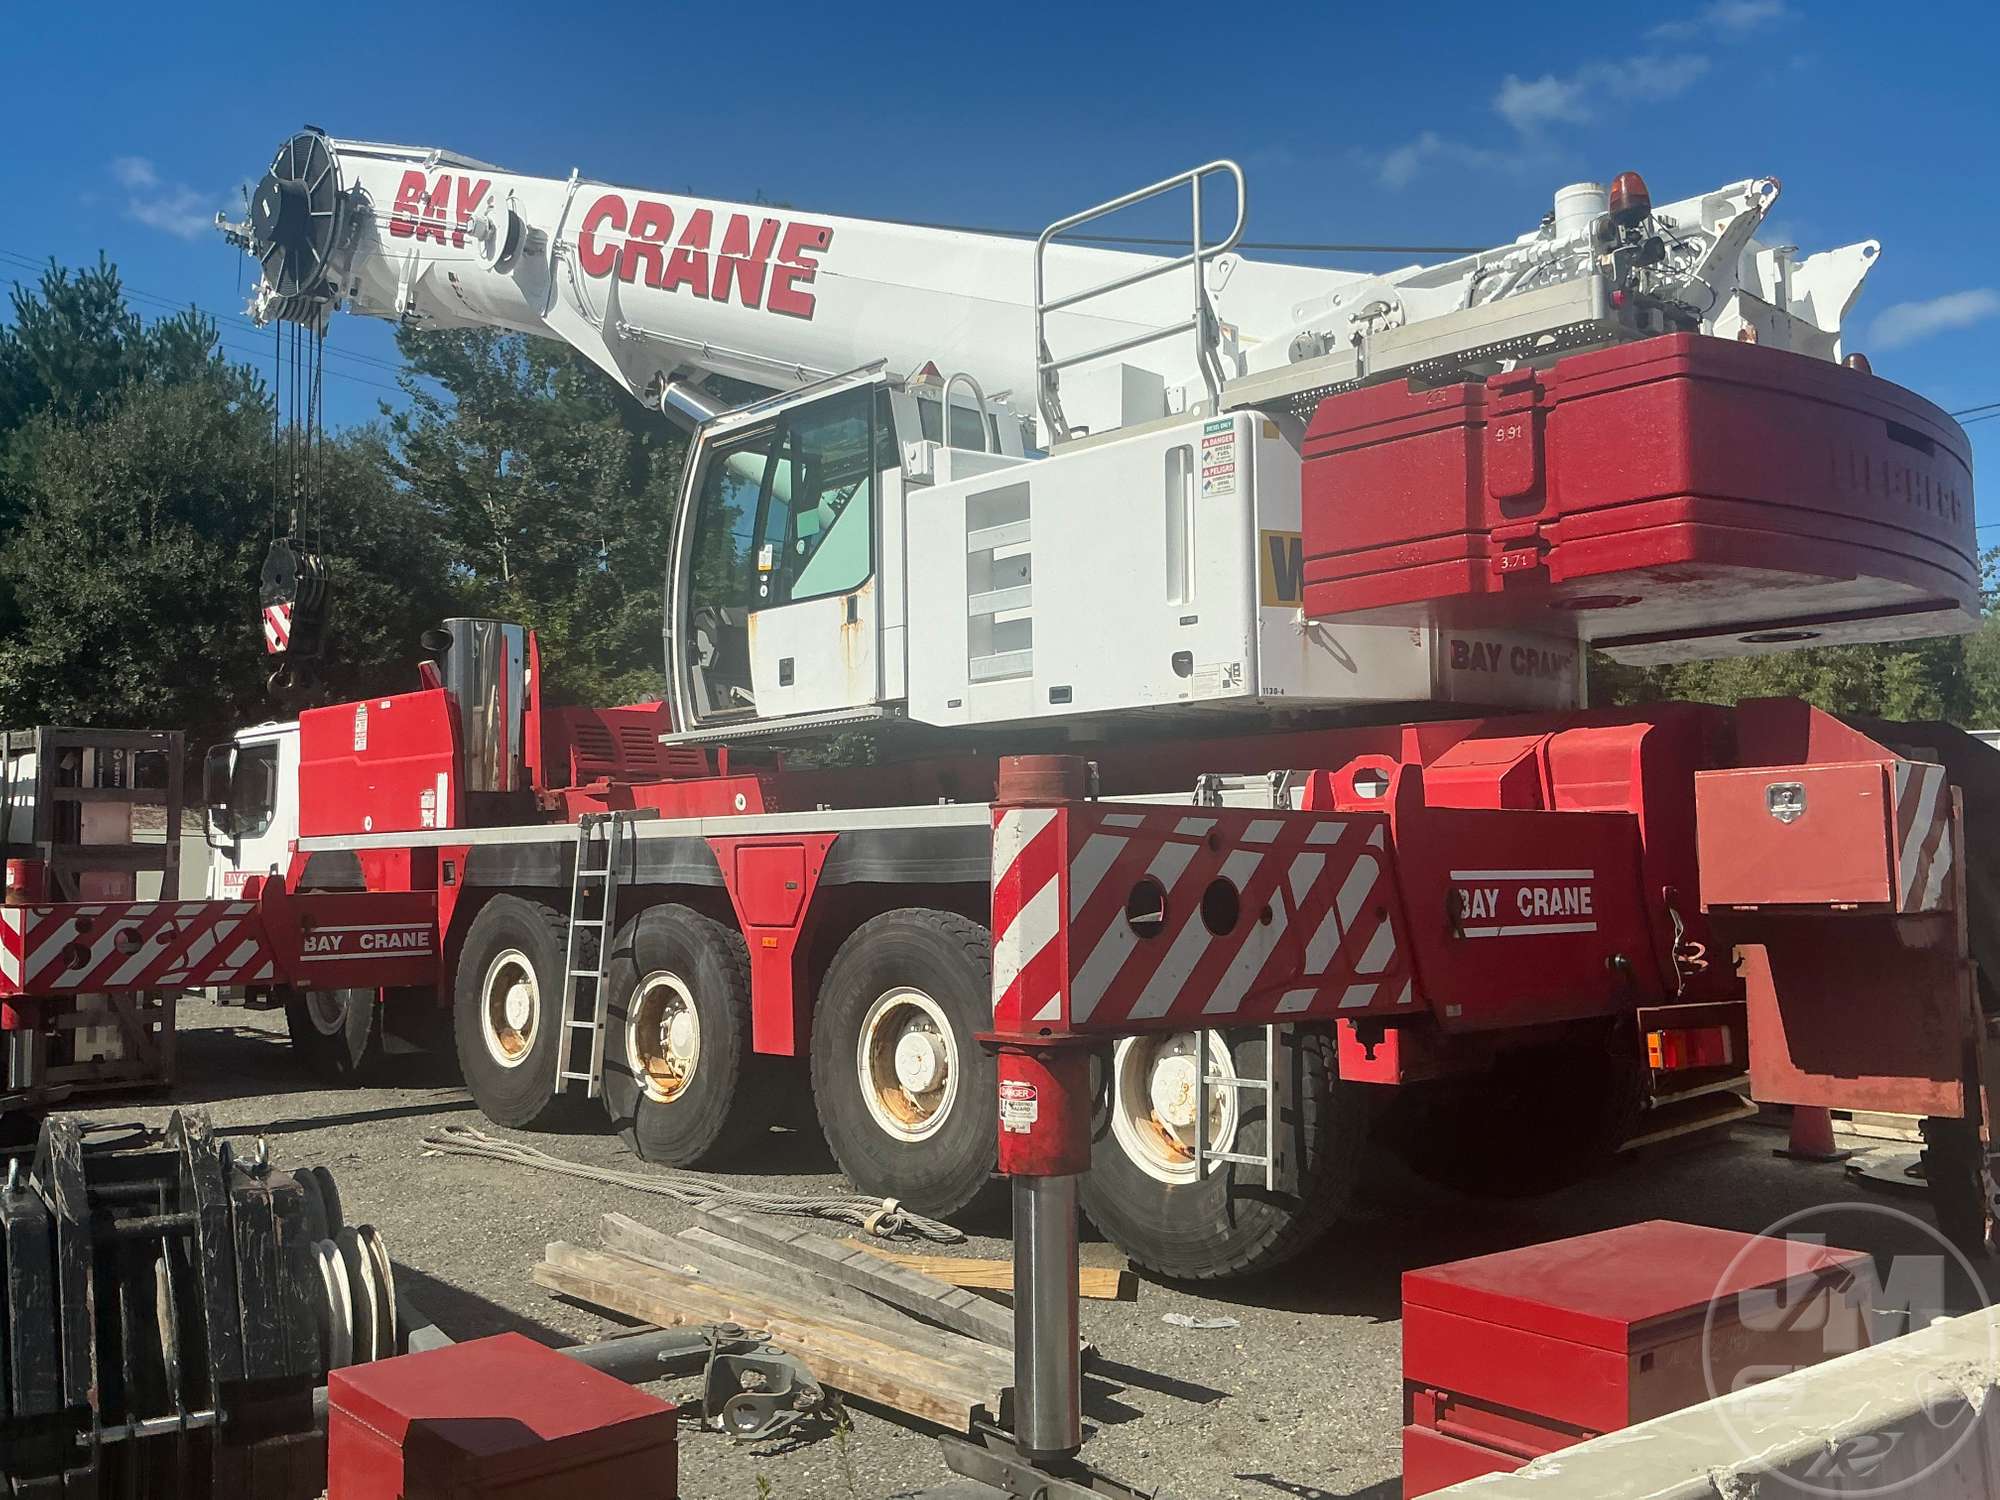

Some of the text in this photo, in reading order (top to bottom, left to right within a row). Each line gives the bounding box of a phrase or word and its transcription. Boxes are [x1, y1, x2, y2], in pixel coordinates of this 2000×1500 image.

[390, 170, 834, 321] BAY CRANE
[1209, 435, 1233, 446] DANGER
[1451, 639, 1502, 672] BAY
[1458, 886, 1593, 919] BAY CRANE
[304, 931, 430, 952] BAY CRANE
